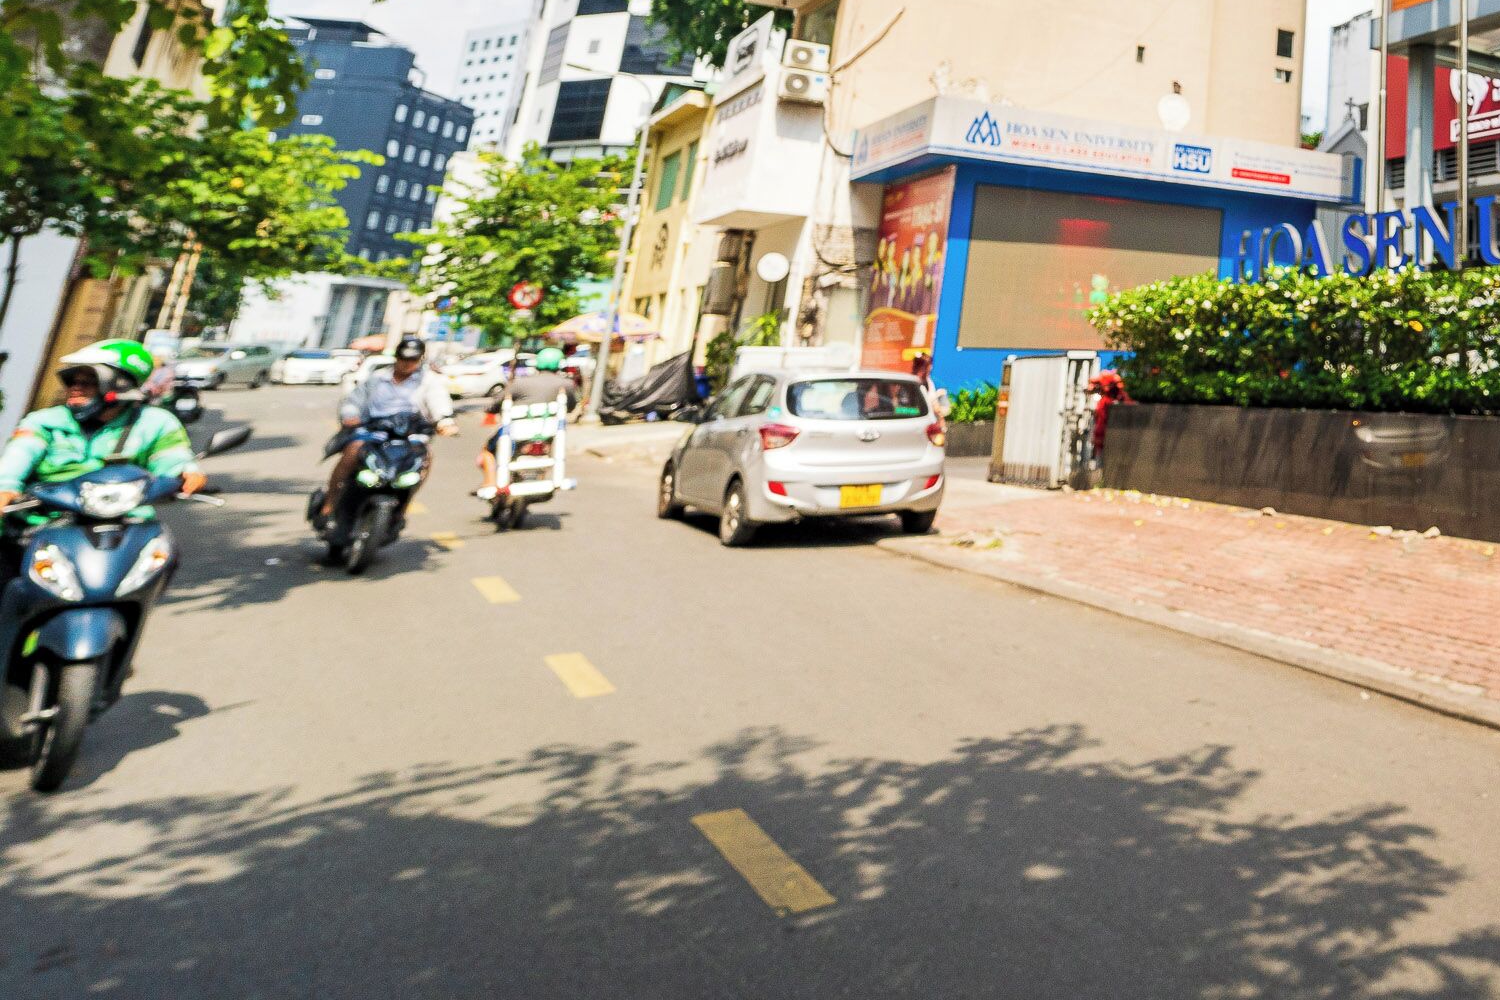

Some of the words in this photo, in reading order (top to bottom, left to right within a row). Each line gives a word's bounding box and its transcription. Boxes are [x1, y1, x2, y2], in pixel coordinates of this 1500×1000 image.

[1174, 151, 1211, 173] HSU
[1233, 219, 1333, 284] HOA
[1342, 198, 1462, 276] SEN
